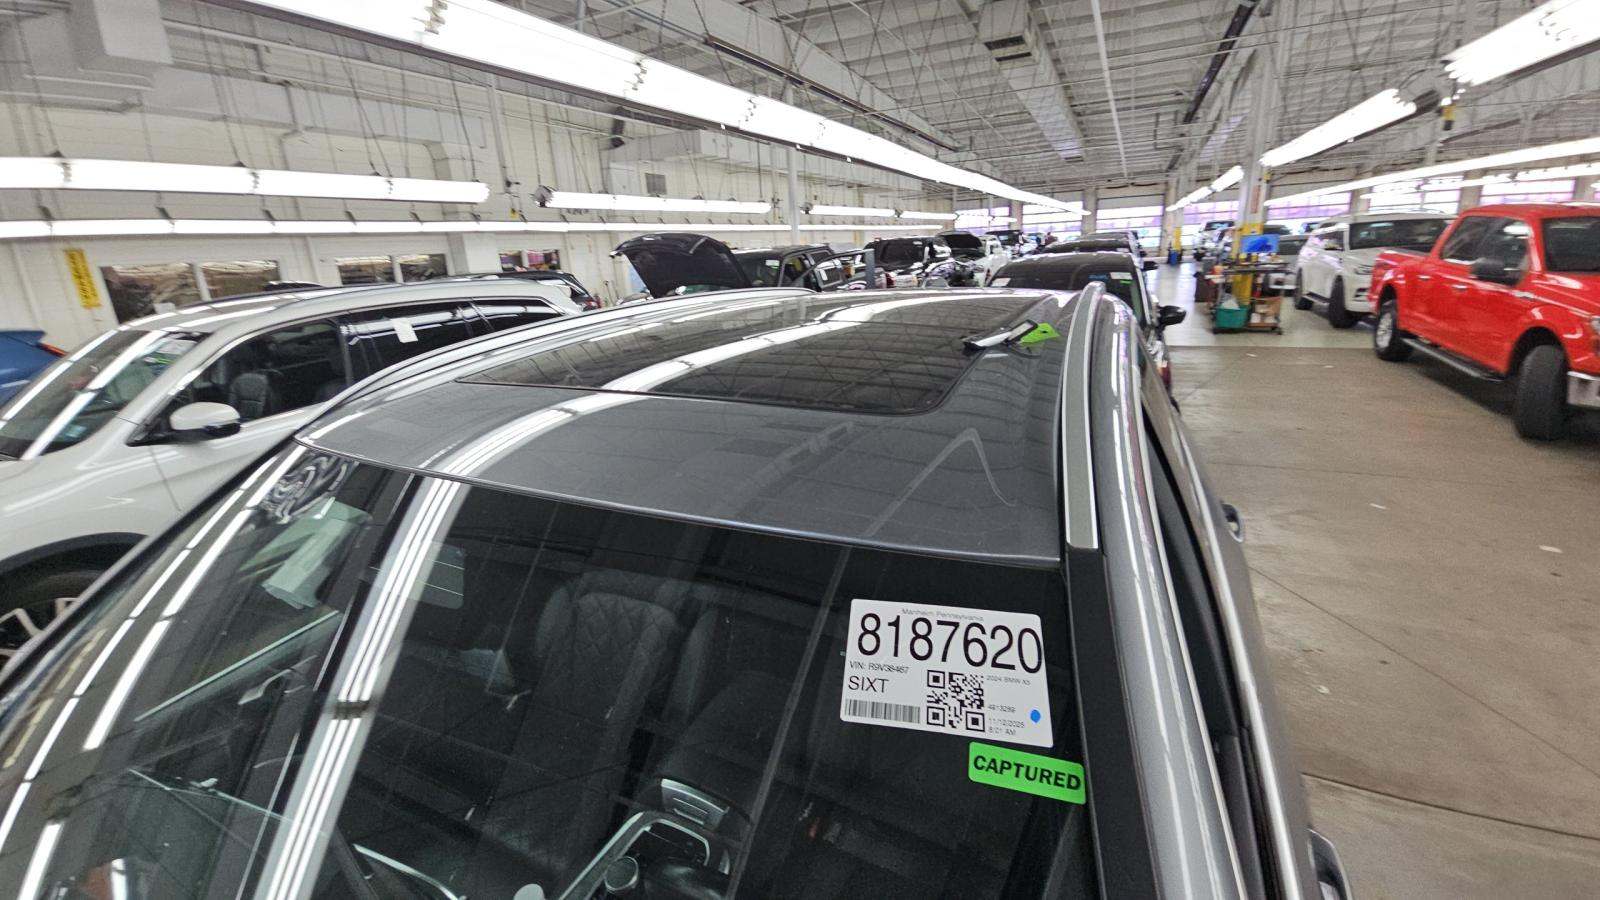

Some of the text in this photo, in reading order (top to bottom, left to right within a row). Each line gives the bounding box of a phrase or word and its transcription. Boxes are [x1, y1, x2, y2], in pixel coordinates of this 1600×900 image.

[857, 613, 1043, 674] 8187620
[848, 675, 890, 693] SIXT
[973, 755, 1081, 791] CAPTURED
